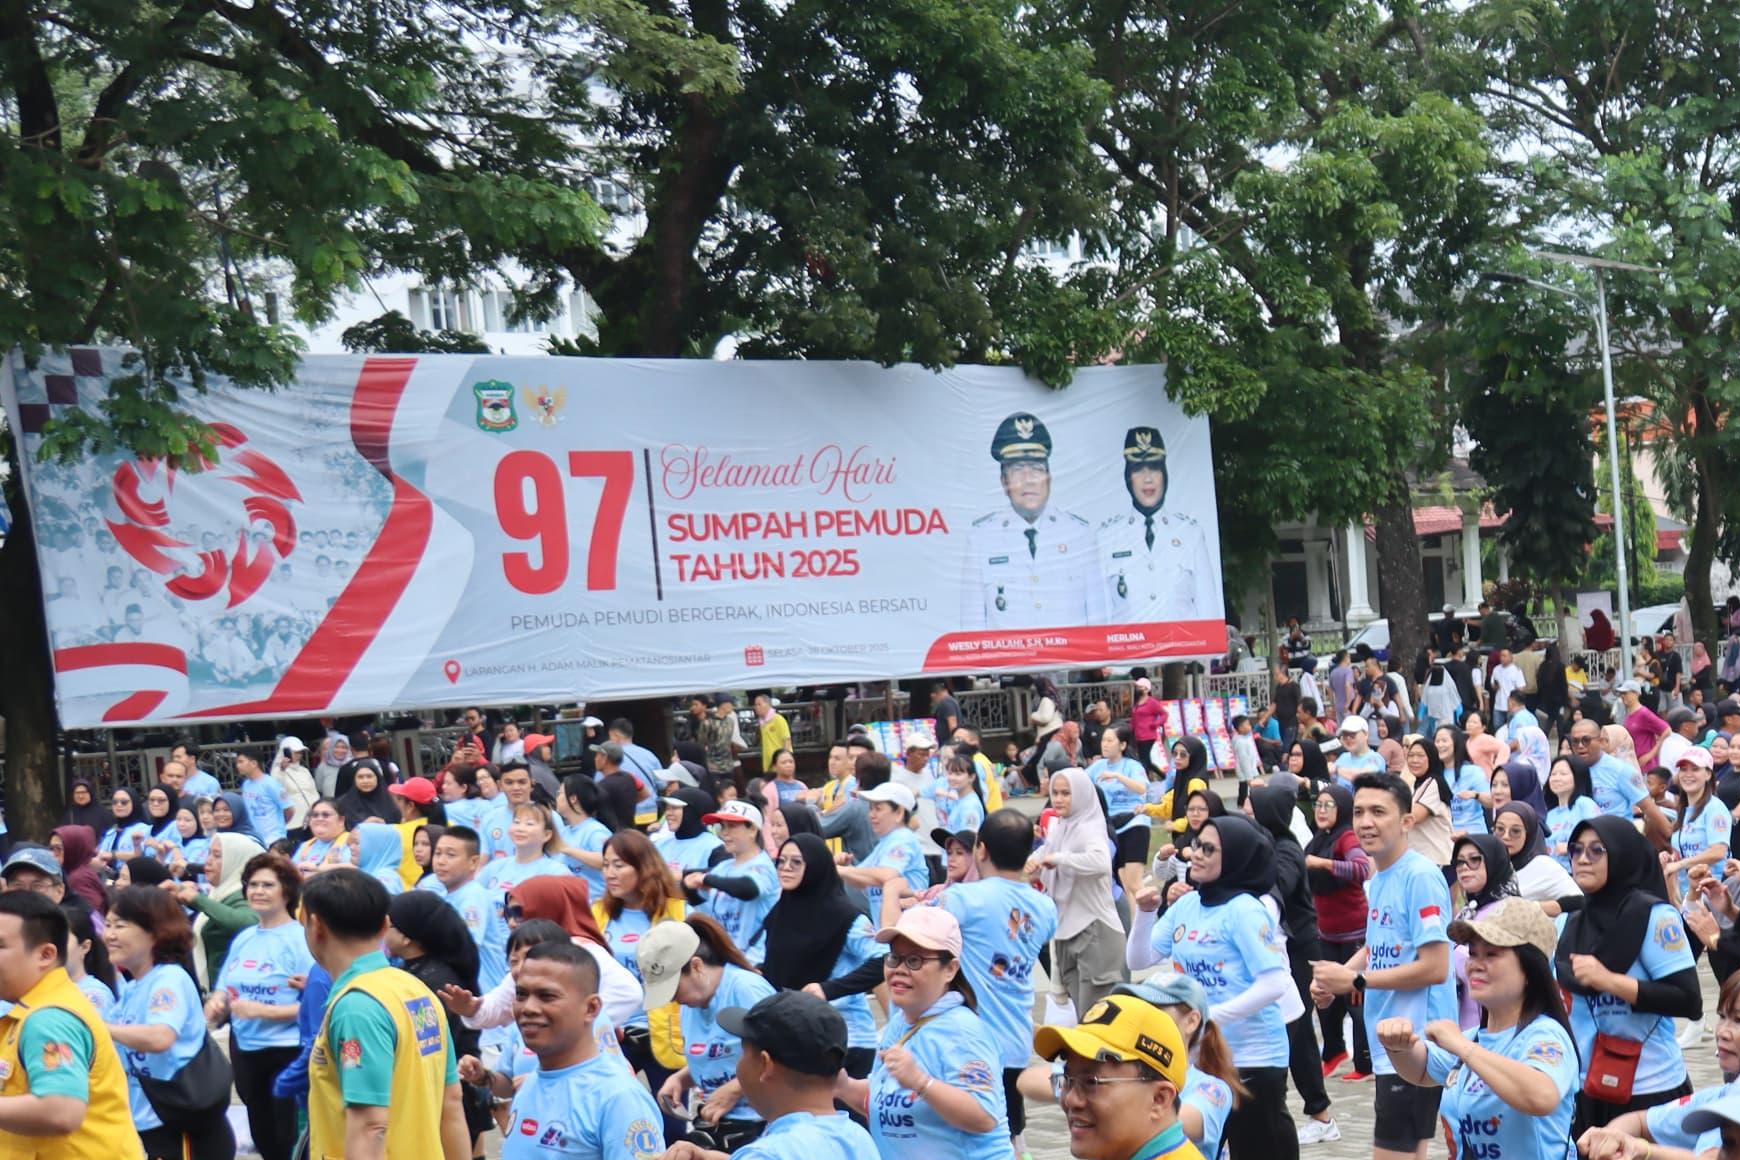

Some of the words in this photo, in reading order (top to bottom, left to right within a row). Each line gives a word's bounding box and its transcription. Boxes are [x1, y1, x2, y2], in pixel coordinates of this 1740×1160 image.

[661, 444, 804, 500] Selamat
[810, 445, 897, 503] Hari
[494, 450, 634, 594] 97
[667, 511, 808, 542] SUMPAH
[815, 508, 949, 537] PEMUDA
[670, 551, 785, 582] TAHUN
[791, 548, 860, 578] 2025
[511, 611, 589, 631] PEMUDA
[594, 608, 663, 626] PEMUDI
[669, 606, 762, 624] BERGERAK,
[767, 601, 854, 619] INDONESIA
[859, 597, 928, 614] BERSATU
[948, 639, 980, 652] WESLY
[1107, 632, 1145, 643] HERLINA
[465, 665, 525, 678] LAPANGAN
[541, 660, 573, 672] ADAM
[1371, 944, 1400, 960] ydro
[1186, 959, 1221, 978] hydro
[240, 983, 276, 996] hydro
[879, 1110, 915, 1128] plus
